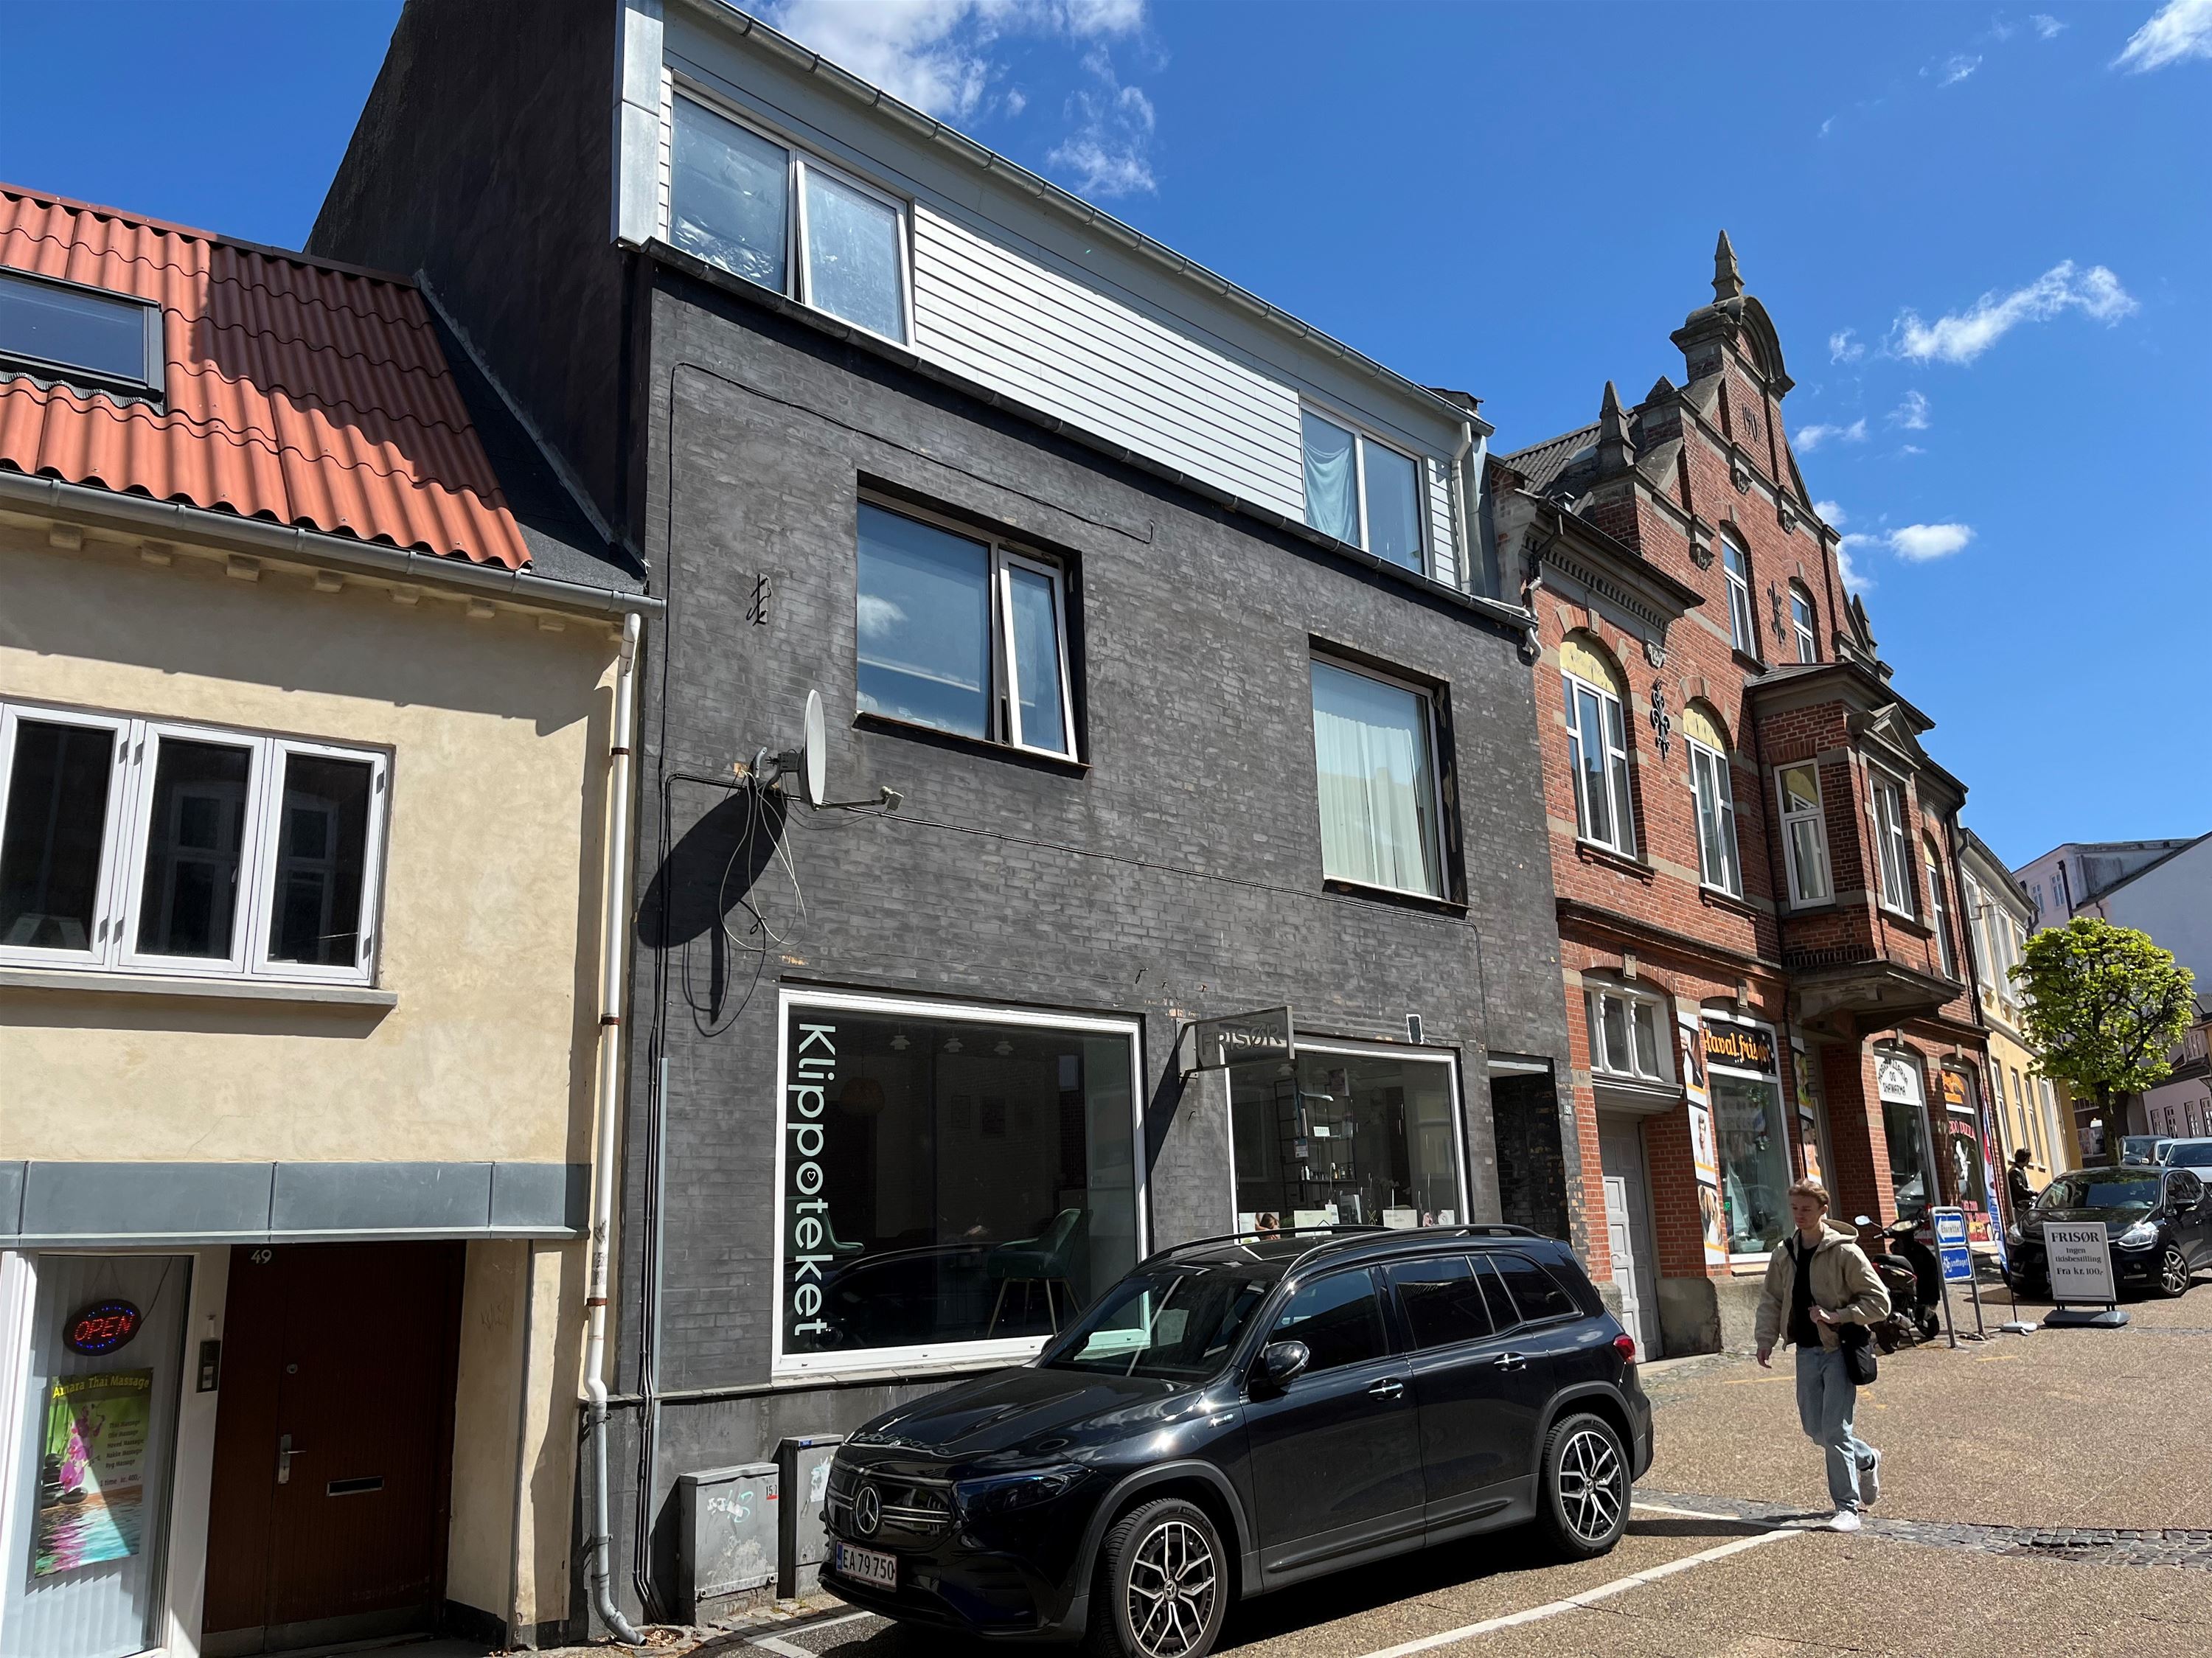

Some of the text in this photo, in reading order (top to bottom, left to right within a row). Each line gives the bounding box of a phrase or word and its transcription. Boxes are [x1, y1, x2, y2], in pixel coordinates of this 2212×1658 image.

[1202, 1023, 1281, 1056] FRISØR
[787, 1023, 836, 1336] Klippoteket
[2051, 1232, 2099, 1242] FRISØR
[251, 1249, 272, 1264] 49
[2055, 1255, 2101, 1264] tidsbestilling
[74, 1314, 135, 1341] OPEN
[88, 1375, 108, 1389] Thai
[110, 1375, 150, 1390] Massage
